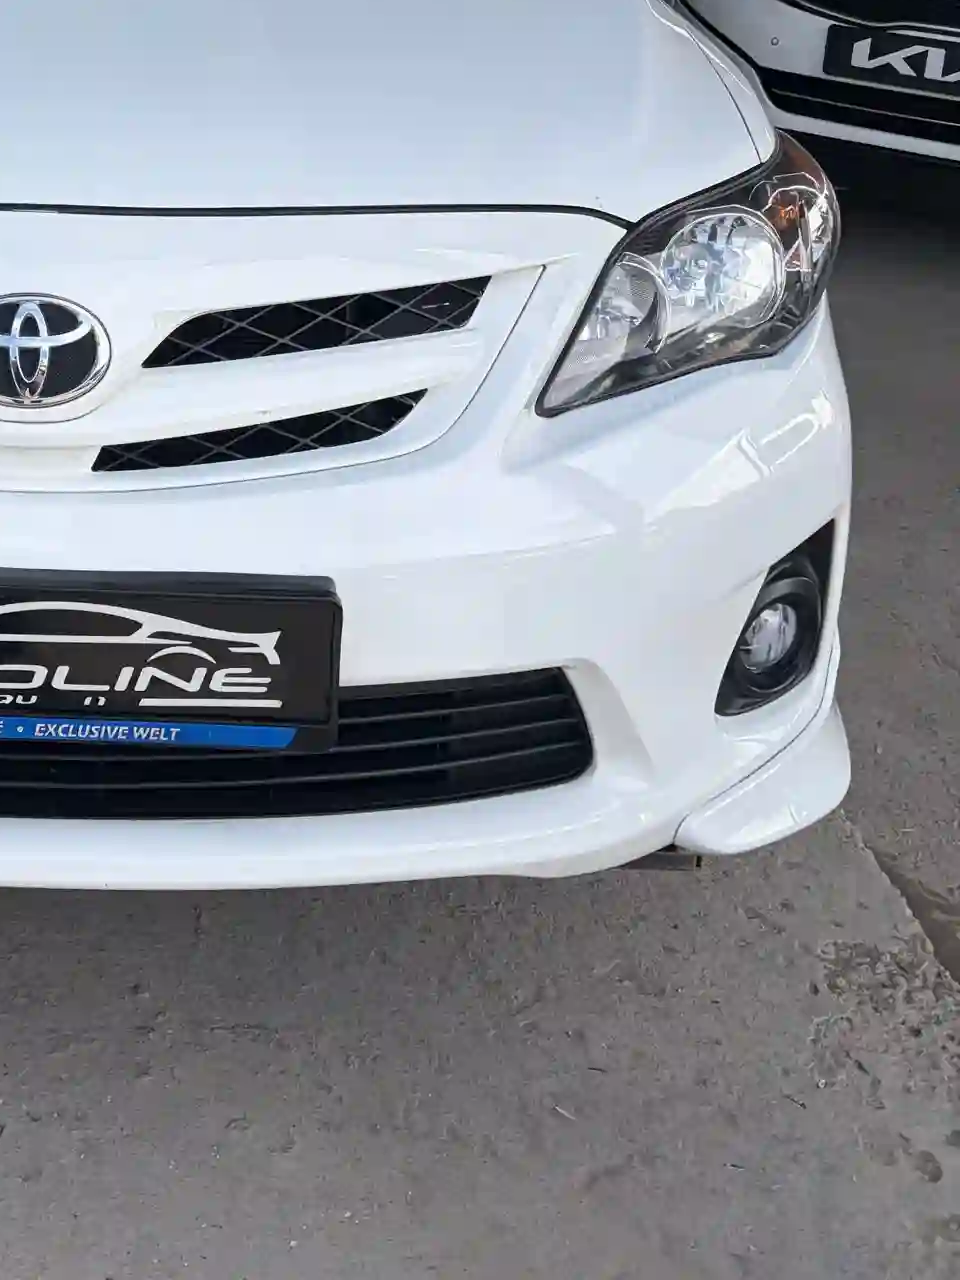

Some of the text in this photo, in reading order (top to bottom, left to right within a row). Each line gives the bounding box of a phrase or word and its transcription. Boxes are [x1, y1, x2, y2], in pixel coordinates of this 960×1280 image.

[851, 37, 960, 83] KI
[34, 722, 129, 740] EXCLUSIVE
[132, 725, 181, 742] WELT
